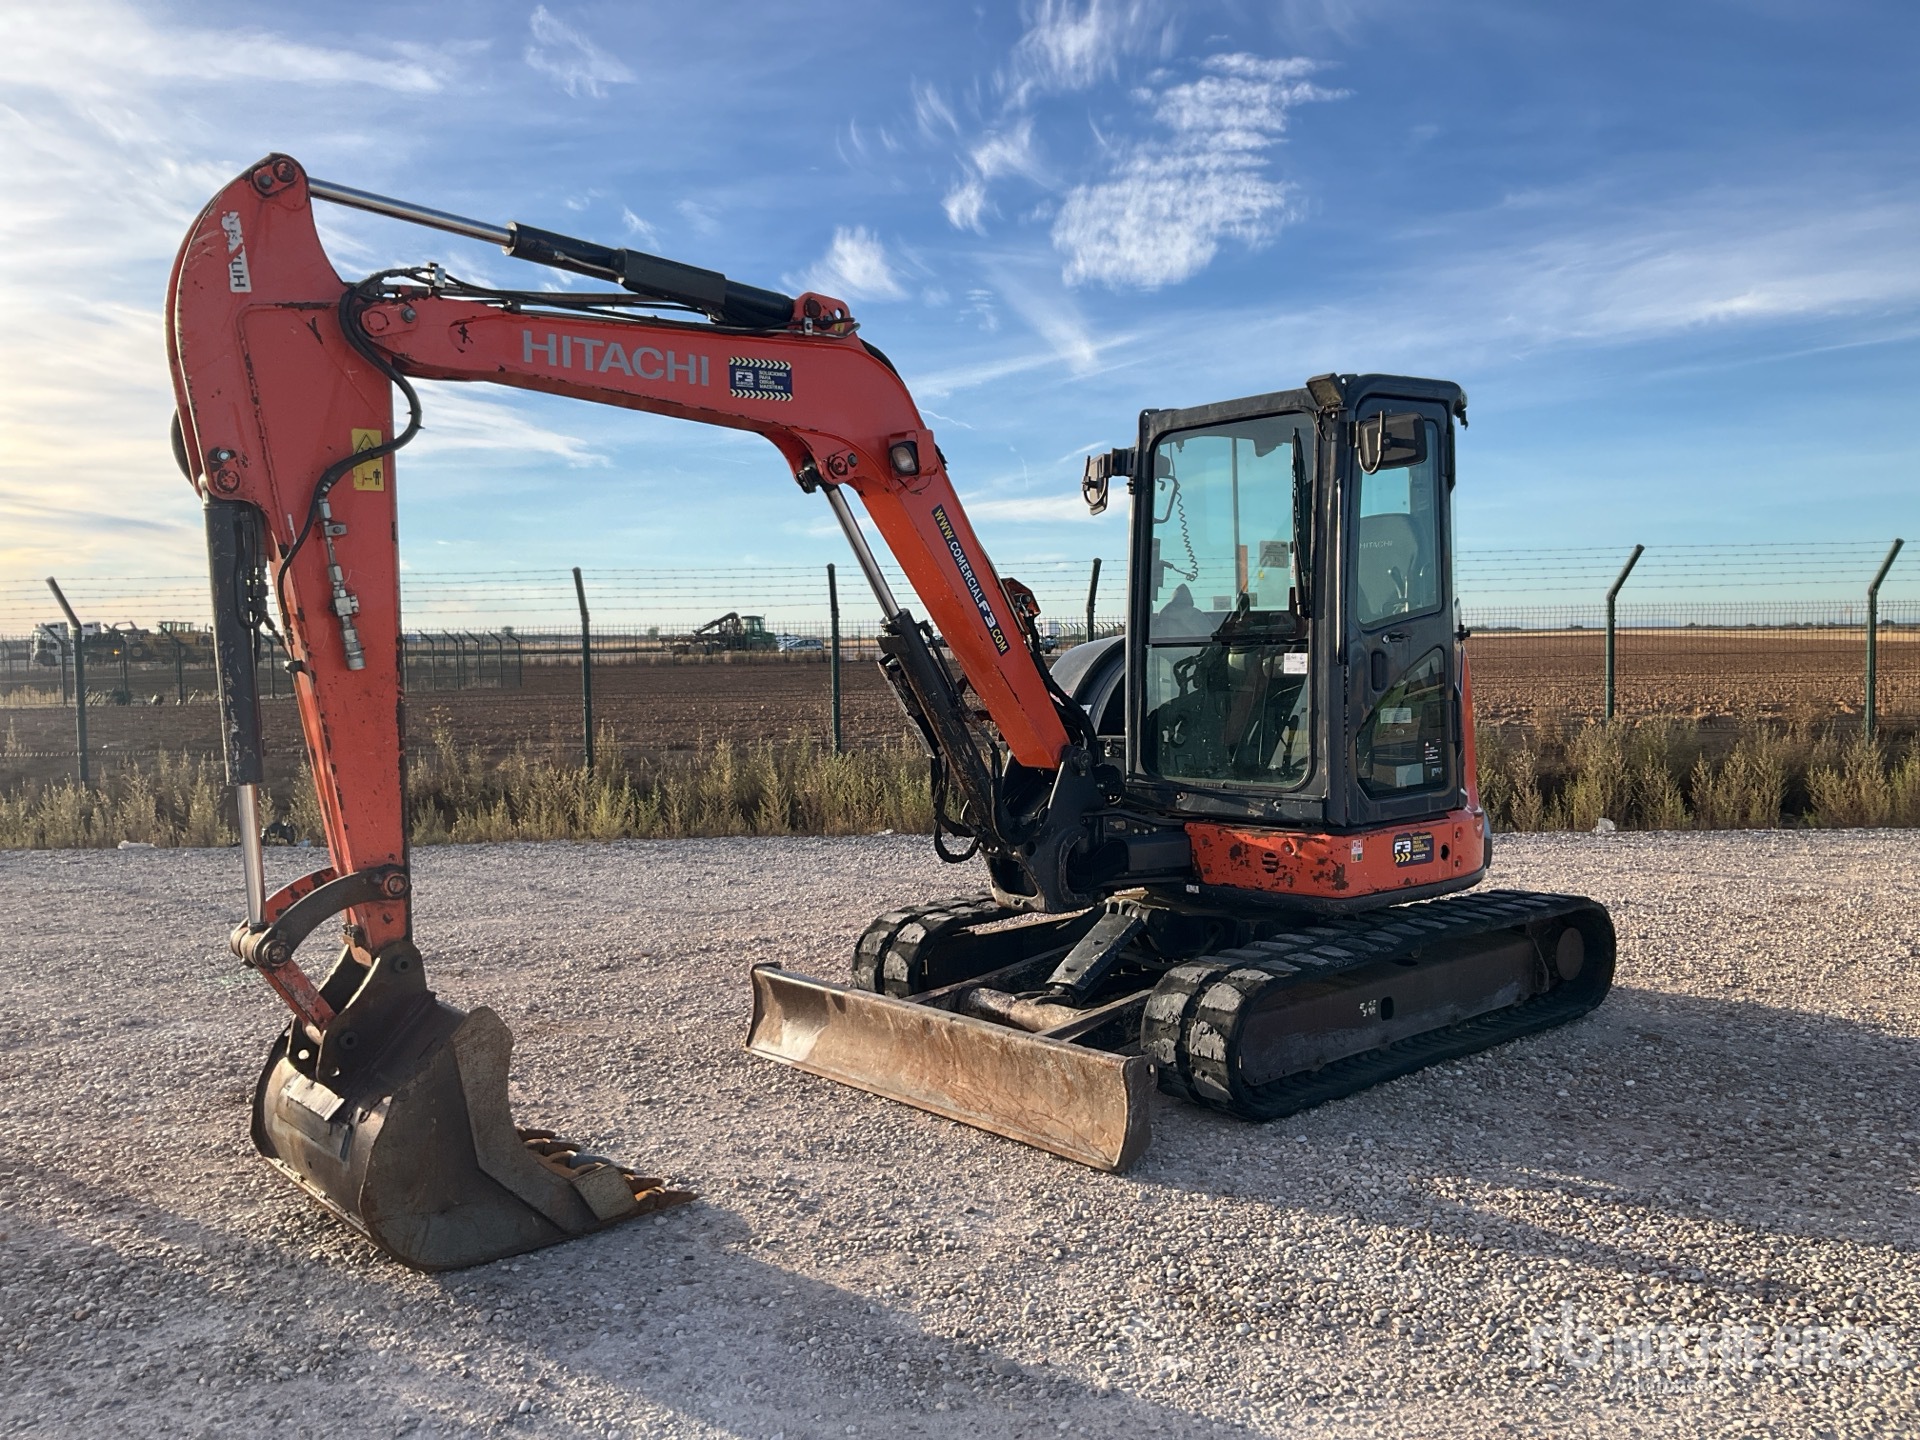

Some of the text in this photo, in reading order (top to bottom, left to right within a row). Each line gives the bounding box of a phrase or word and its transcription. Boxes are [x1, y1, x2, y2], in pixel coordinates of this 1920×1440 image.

[522, 330, 709, 386] HITACHI
[735, 371, 754, 382] F3
[1360, 540, 1392, 549] HITACHI
[935, 508, 1008, 653] WWW.COMERCIALF3.COM
[1394, 840, 1411, 854] F3
